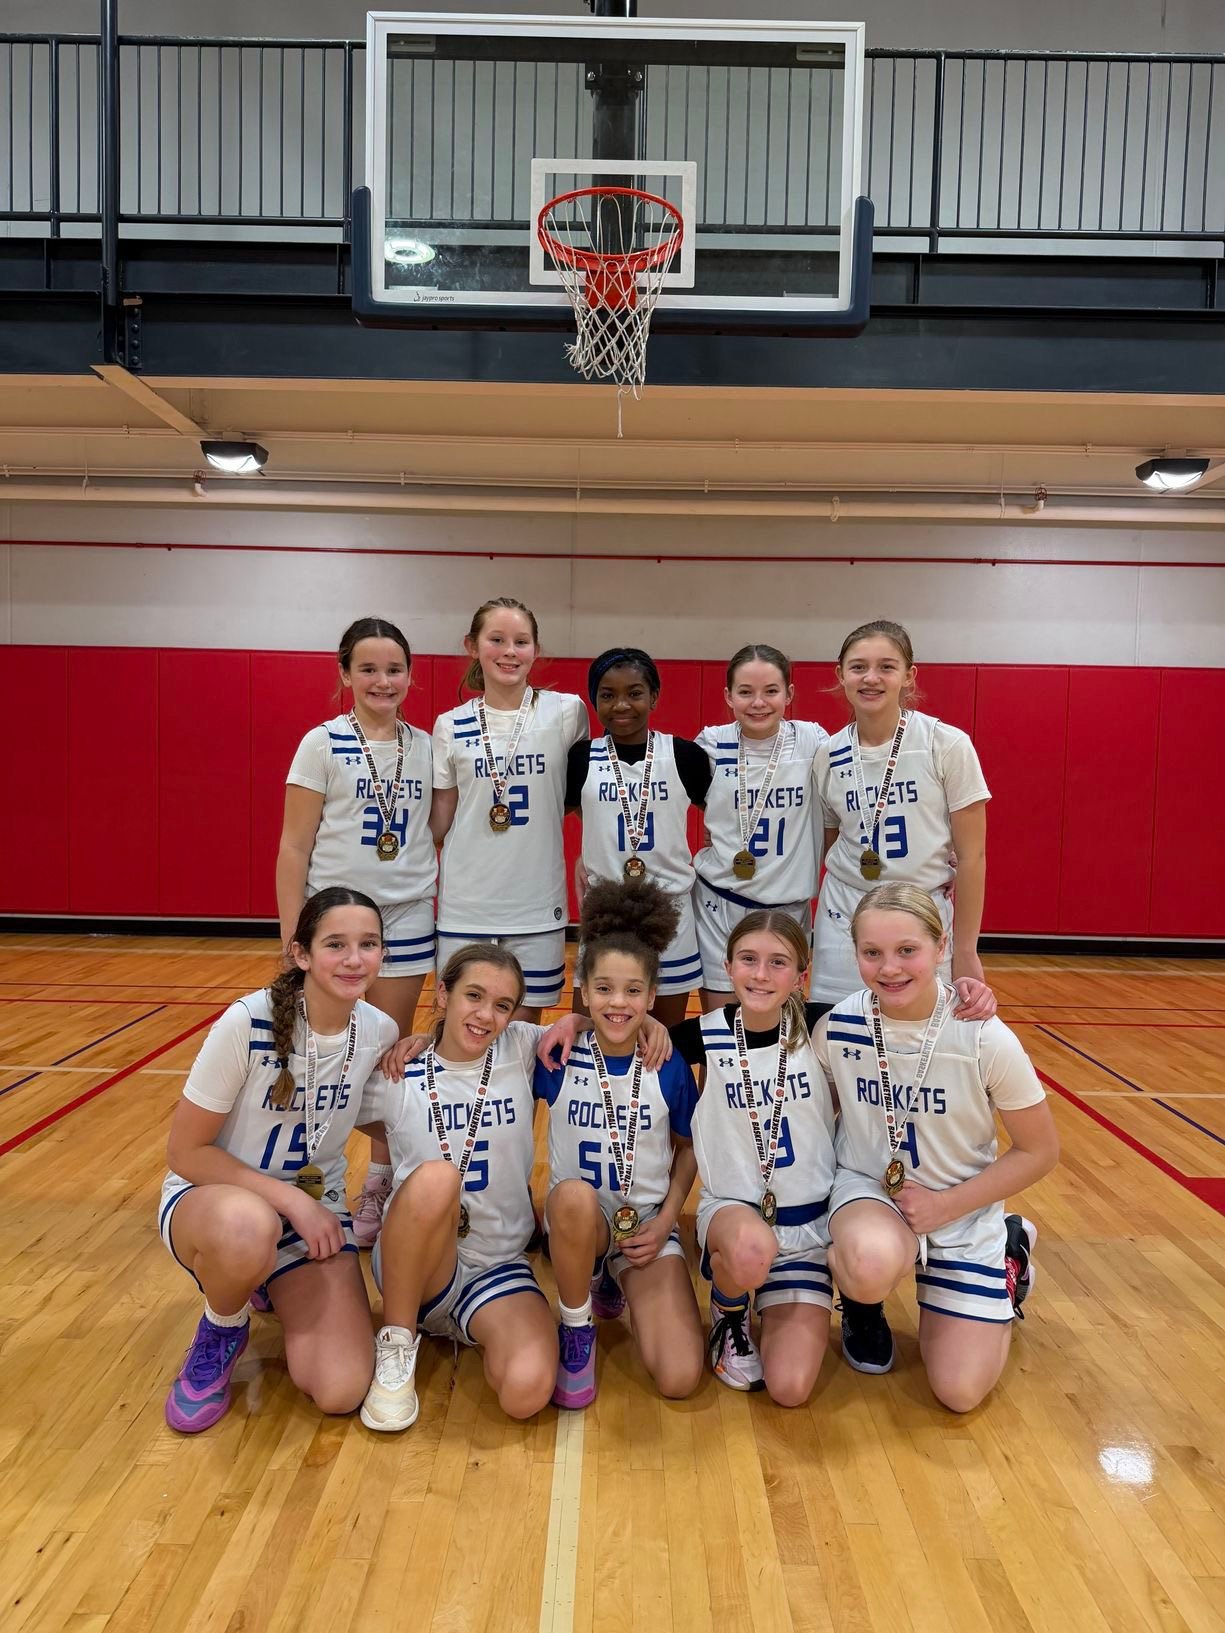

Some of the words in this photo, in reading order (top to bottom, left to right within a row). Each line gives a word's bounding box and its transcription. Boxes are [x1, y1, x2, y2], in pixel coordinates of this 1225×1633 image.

[478, 708, 488, 735] BASKETBALL
[484, 742, 496, 771] BASKETBALL
[891, 726, 905, 759] BASKETBALL
[365, 754, 380, 783] BASKETBALL
[395, 755, 404, 783] BASKETBALL
[612, 761, 624, 788] BASKETBALL
[643, 761, 652, 789] BASKETBALL
[880, 767, 894, 800] BASKETBALL
[361, 806, 408, 847] 34
[621, 796, 633, 828] BASKETBALL
[638, 798, 648, 830] BASKETBALL
[749, 817, 786, 857] 21
[346, 1022, 357, 1062] BASKETBALL
[735, 1019, 746, 1057] BASKETBALL
[872, 1017, 886, 1058] BASKETBALL
[427, 1053, 436, 1090] BASKETBALL
[591, 1043, 607, 1079] BASKETBALL
[631, 1060, 643, 1099] BASKETBALL
[776, 1048, 788, 1088] BASKETBALL
[742, 1069, 756, 1109] BASKETBALL
[880, 1070, 894, 1112] BASKETBALL
[431, 1101, 447, 1141] BASKETBALL
[468, 1098, 484, 1138] BASKETBALL
[603, 1090, 617, 1129] BASKETBALL
[771, 1100, 783, 1140] BASKETBALL
[626, 1111, 638, 1151] BASKETBALL
[752, 1121, 765, 1162] BASKETBALL
[895, 1121, 920, 1169] 4
